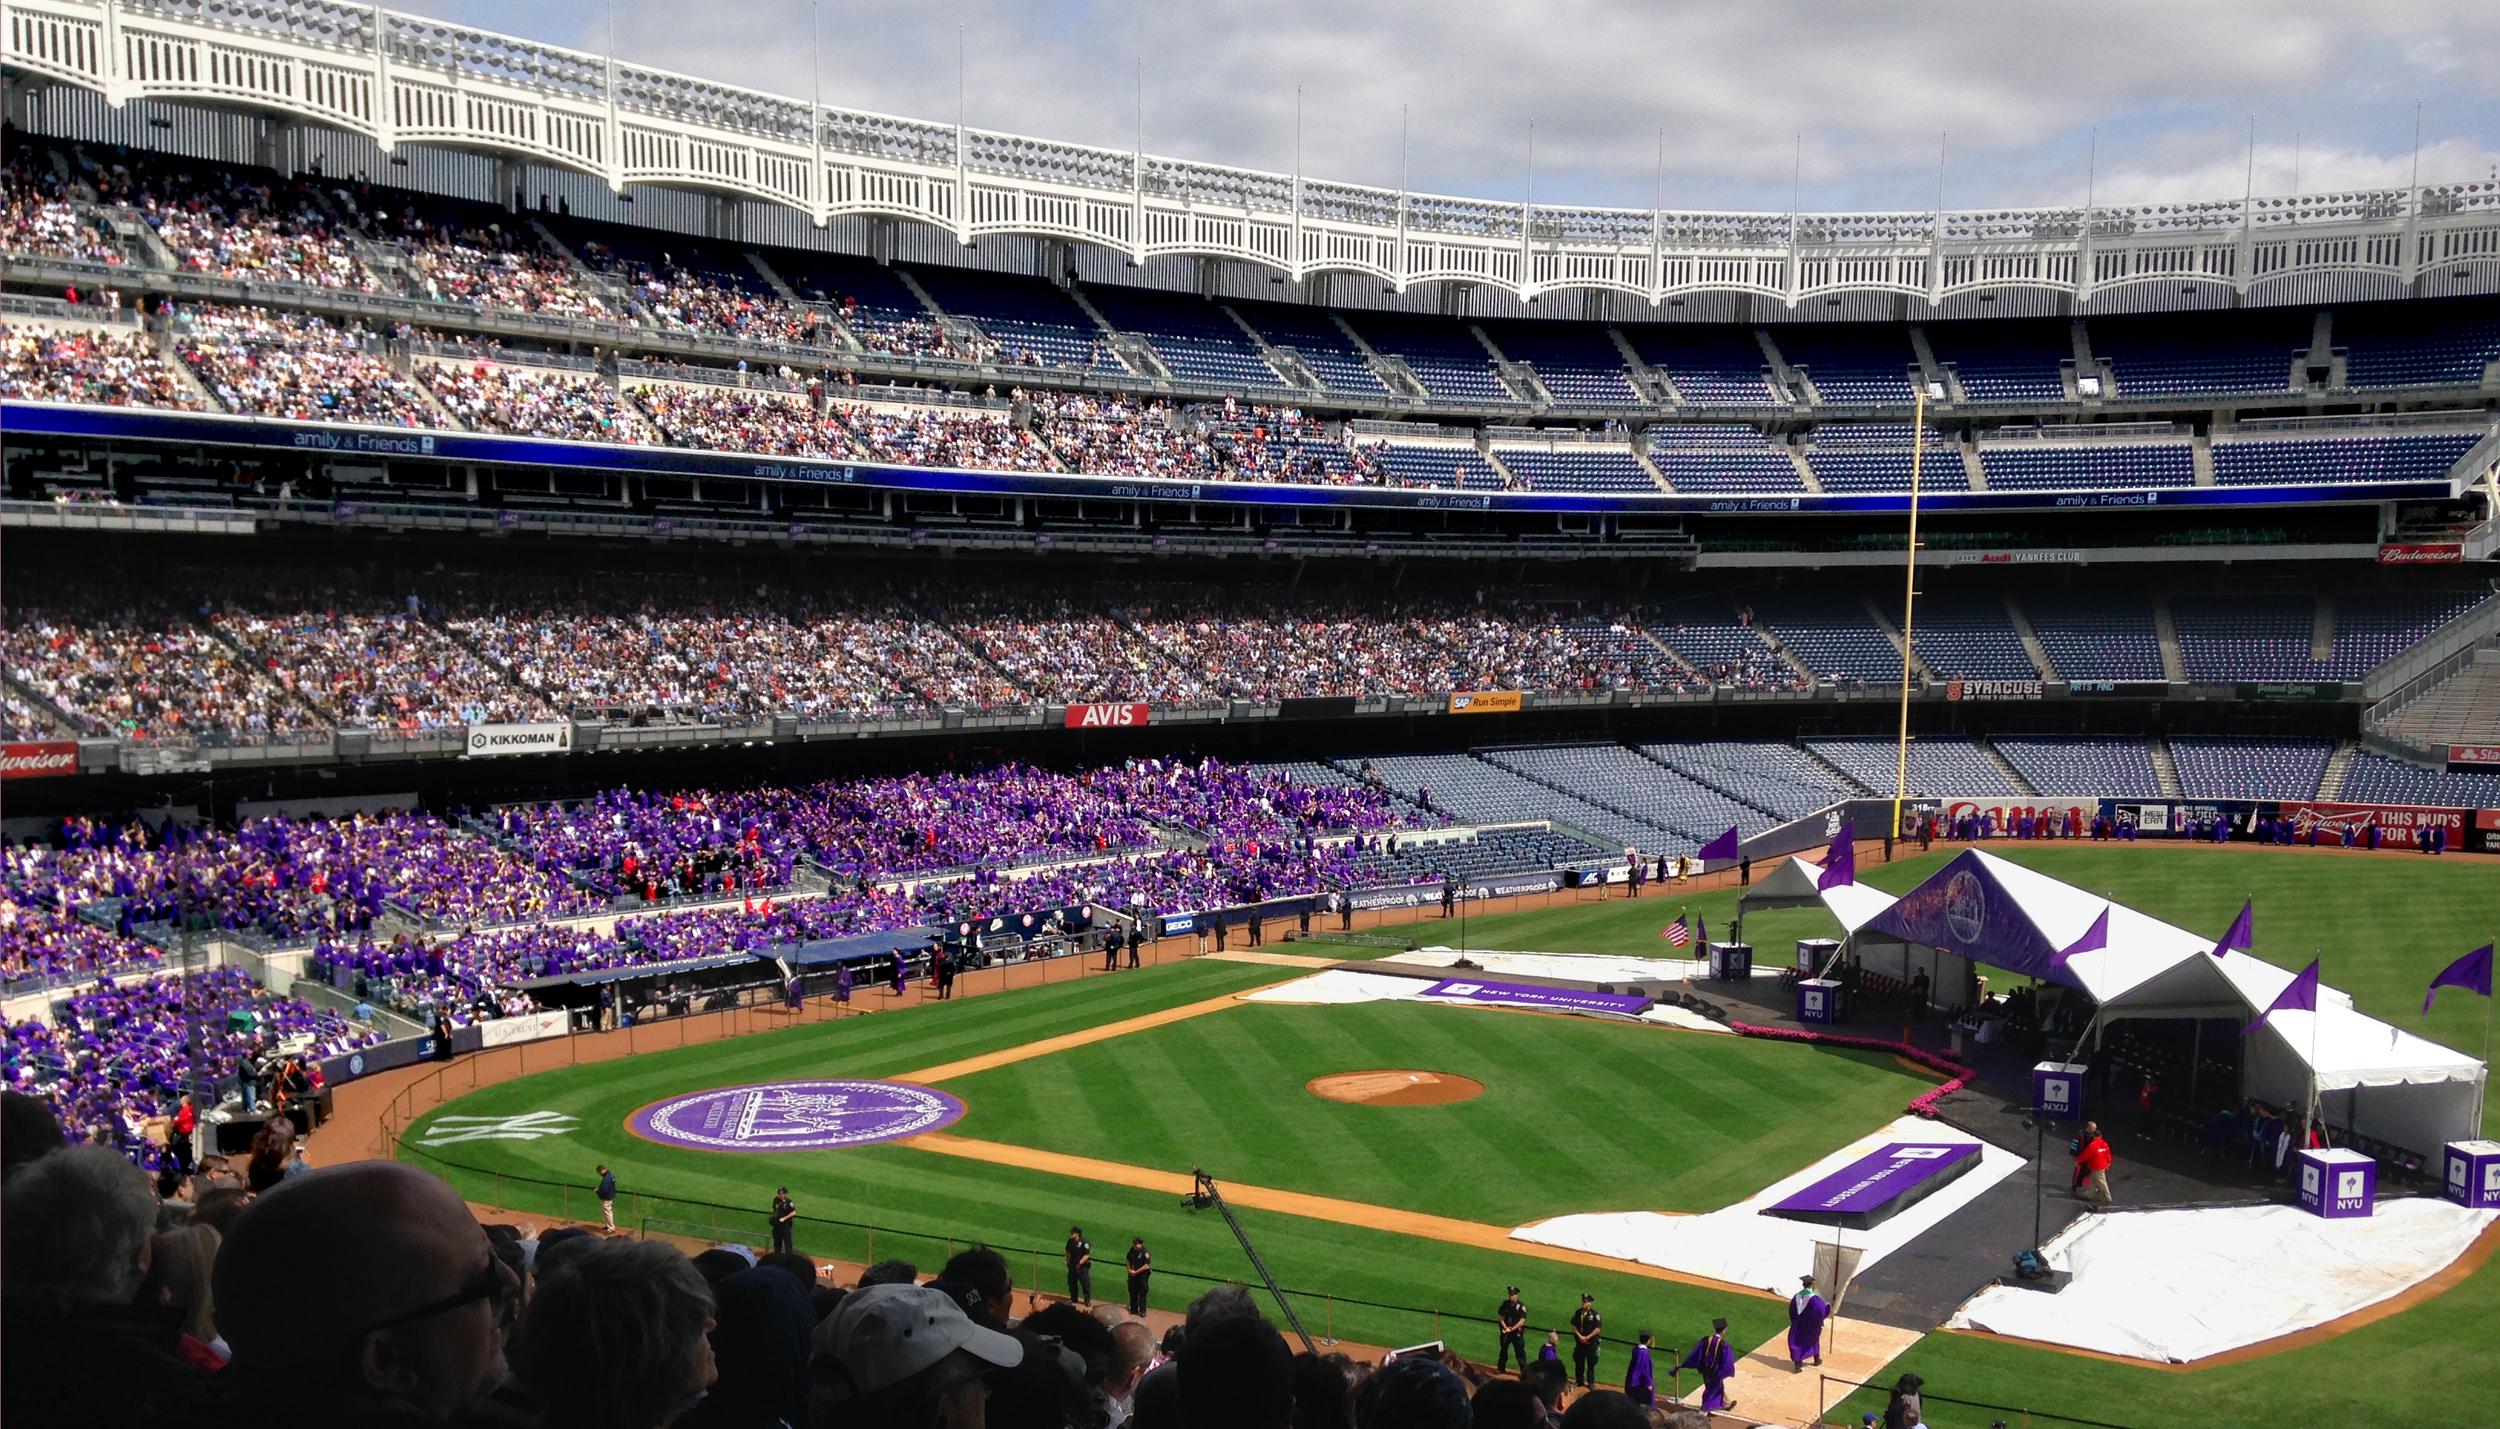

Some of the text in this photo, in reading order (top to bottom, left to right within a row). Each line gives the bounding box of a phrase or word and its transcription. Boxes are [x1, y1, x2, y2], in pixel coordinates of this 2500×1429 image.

[294, 432, 340, 449] amily
[358, 434, 418, 452] Friends
[754, 464, 786, 479] amily
[799, 466, 841, 480] Friends
[1112, 484, 1140, 497] amily
[1151, 485, 1190, 498] Friends
[1417, 496, 1441, 508] amily
[1449, 496, 1481, 507] Friends
[1710, 500, 1739, 511] amily
[1750, 499, 1789, 510] Friends
[2056, 495, 2088, 507] amily
[2101, 494, 2145, 504] Friends
[1981, 552, 2080, 562] Audi YANKEES CLUB
[2381, 548, 2460, 561] Budweiser
[1963, 682, 2043, 694] SYRACUSE
[2070, 683, 2115, 691] ARTS AND
[2257, 682, 2316, 695] Poland Spring
[1454, 697, 1517, 708] SAP Run Simple
[1081, 704, 1134, 726] AVIS
[490, 733, 555, 745] KIKKOMAN
[2381, 811, 2413, 825] THIS
[2380, 827, 2407, 841] FOR
[1582, 872, 1600, 885] AC
[1424, 889, 1477, 901] WEATPROOF
[1495, 883, 1547, 895] WEATHERPROOF
[1166, 920, 1193, 931] GEICO
[1550, 996, 1626, 1007] UNIVERSITY
[1804, 1010, 1823, 1018] NYU
[512, 1024, 537, 1034] TRUST
[2043, 1102, 2069, 1112] NYU
[2448, 1183, 2465, 1199] NYU
[2484, 1191, 2500, 1202] NY
[2301, 1191, 2319, 1206] NYU
[2337, 1199, 2363, 1210] NYU
